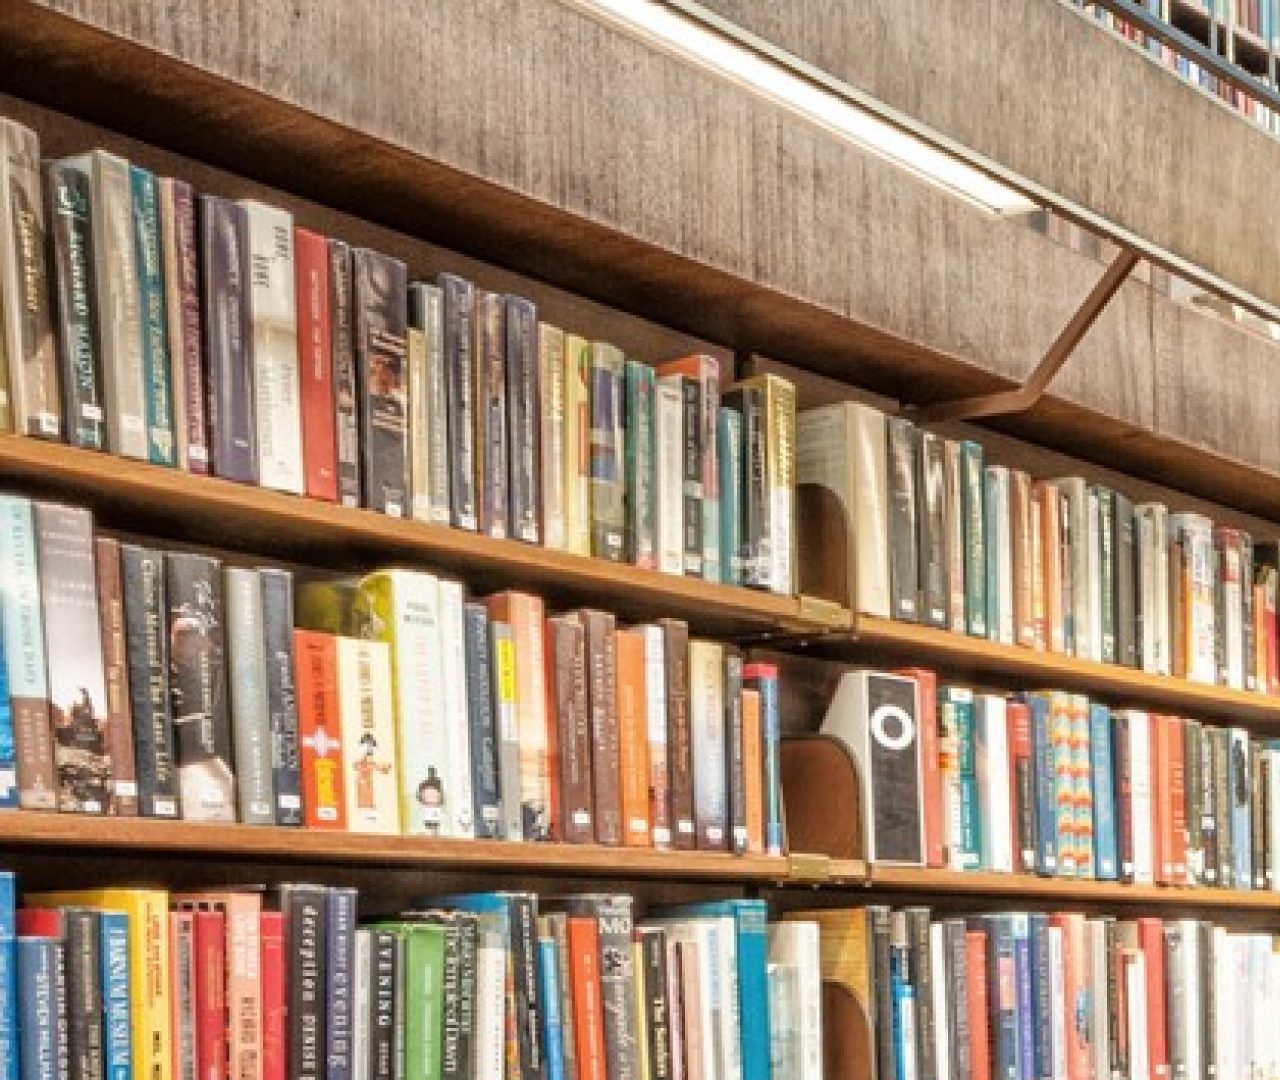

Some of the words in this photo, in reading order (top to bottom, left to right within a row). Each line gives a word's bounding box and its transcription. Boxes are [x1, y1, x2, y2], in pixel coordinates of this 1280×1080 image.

[871, 705, 914, 750] O
[300, 905, 318, 1001] deception
[378, 935, 393, 1027] EVENING
[302, 1015, 317, 1070] DENISE
[328, 972, 349, 1069] evening
